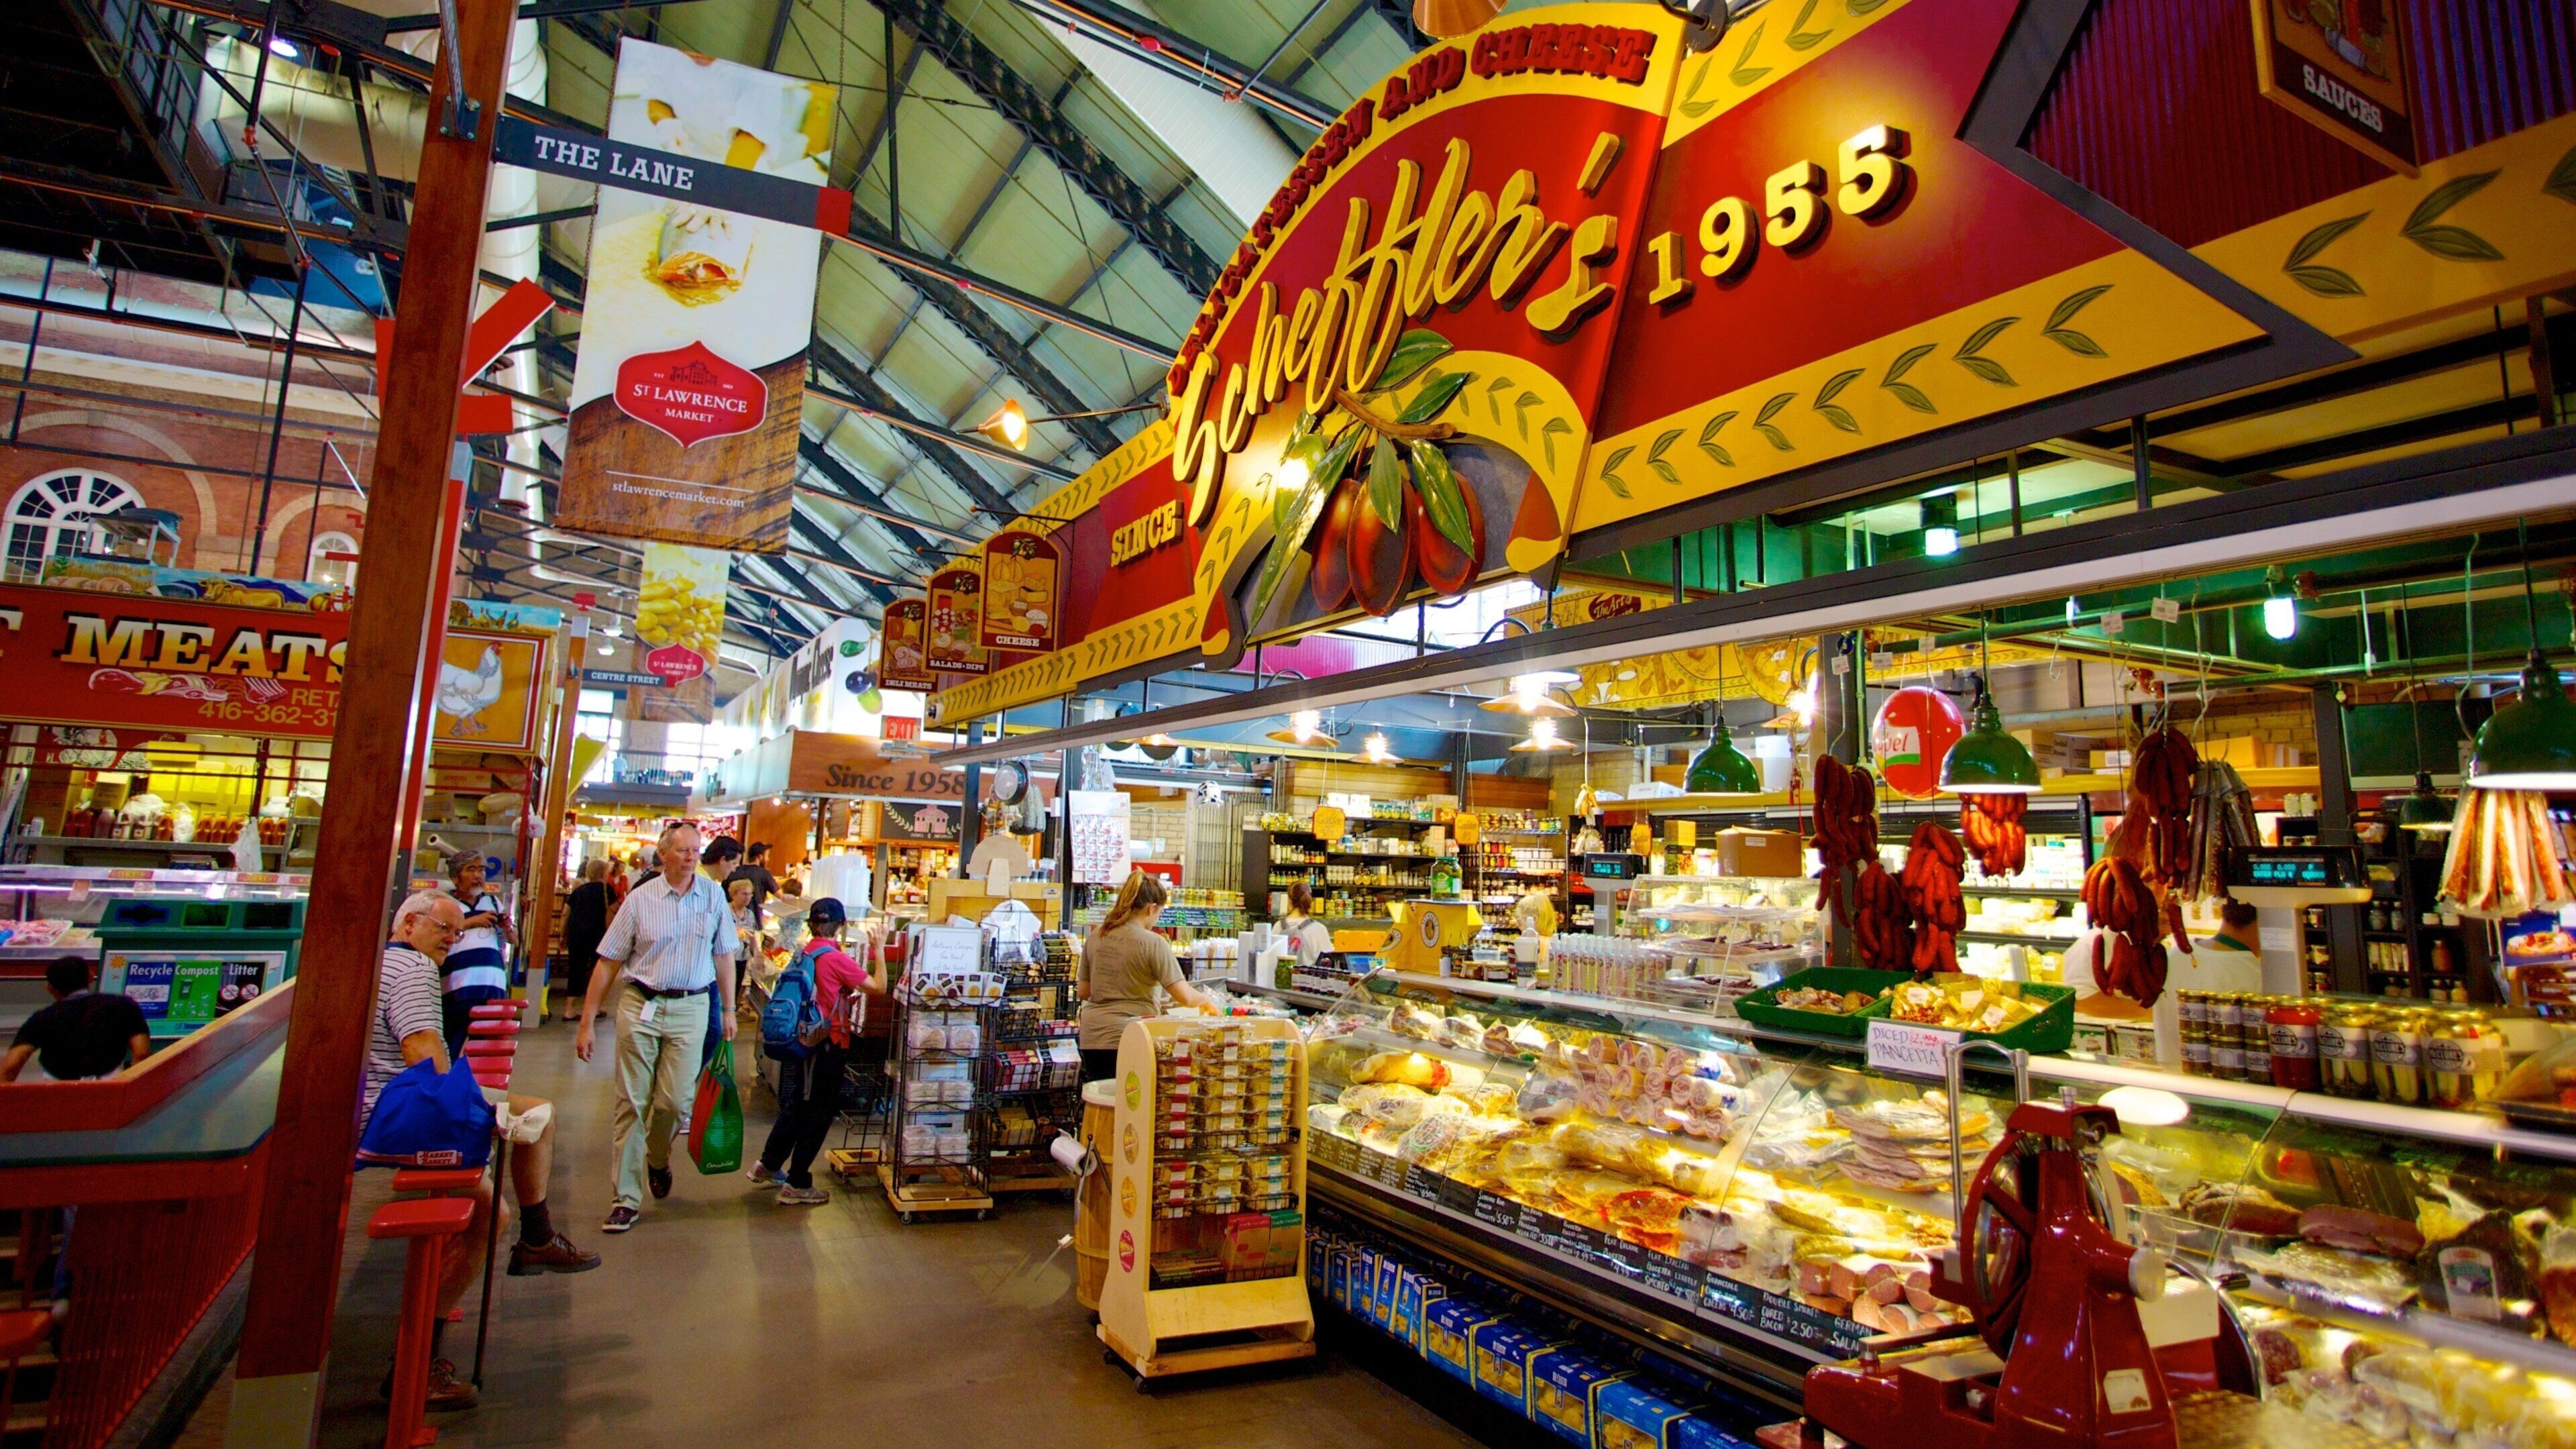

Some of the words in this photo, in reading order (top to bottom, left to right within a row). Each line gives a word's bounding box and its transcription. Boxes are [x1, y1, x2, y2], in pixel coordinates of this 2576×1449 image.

[2303, 64, 2383, 133] SAUCES
[535, 136, 600, 170] THE
[609, 152, 694, 191] LANE
[1169, 98, 1376, 397] DELICATESSEN
[1378, 46, 1466, 122] AND
[1471, 23, 1656, 85] CHEESE
[1648, 123, 1907, 305] 1955
[1172, 131, 1618, 527] Scheffler's
[653, 386, 748, 413] LAWRENCE
[665, 407, 715, 423] MARKET
[612, 480, 745, 508] stlawrencemarket.com
[1110, 500, 1183, 568] SINCE
[996, 635, 1040, 647] CHEESE
[591, 672, 625, 681] CENTRE
[627, 674, 660, 684] STREET
[904, 681, 932, 690] MEATS
[885, 716, 917, 739] EXIT
[826, 763, 895, 791] Since
[904, 770, 965, 796] 1958
[129, 963, 173, 979] Recycle
[174, 965, 219, 977] Compost
[229, 963, 258, 975] Litter
[1872, 1027, 1909, 1044] DICED
[1872, 1042, 1940, 1068] PANCETTA
[1604, 1234, 1617, 1246] FLAT
[1648, 1250, 1661, 1262] FLAT
[1664, 1255, 1690, 1271] ITALIAN
[1644, 1275, 1670, 1291] SMOKED
[1761, 1305, 1784, 1322] CURED
[1763, 1291, 1791, 1309] DOUBLE
[1793, 1301, 1820, 1318] SMOKED
[1760, 1317, 1784, 1332] BACON
[1834, 1317, 1873, 1337] GERMAN
[1833, 1331, 1860, 1352] SALA
